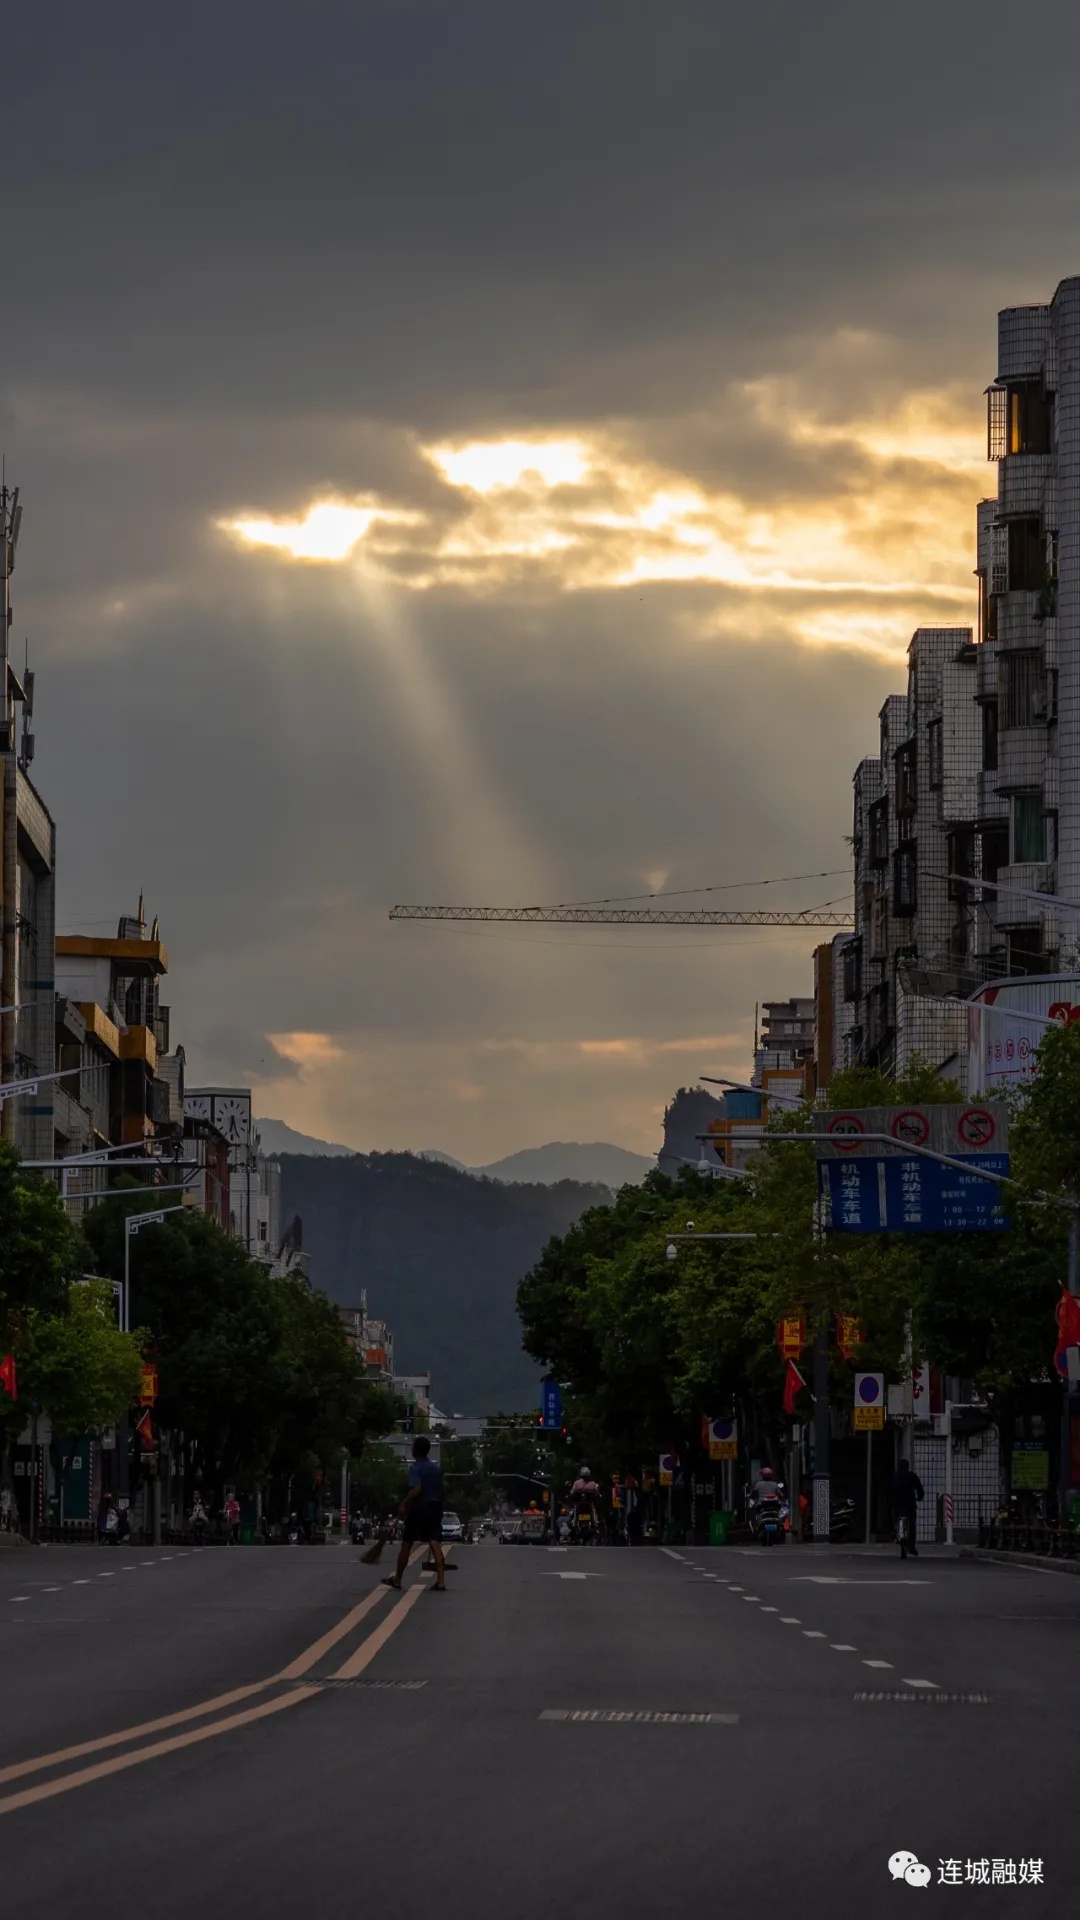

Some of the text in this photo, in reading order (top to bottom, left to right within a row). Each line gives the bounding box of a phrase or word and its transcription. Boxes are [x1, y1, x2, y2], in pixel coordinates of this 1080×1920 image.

[840, 1163, 862, 1224] 机动车车道
[900, 1162, 923, 1222] 非机动车车道
